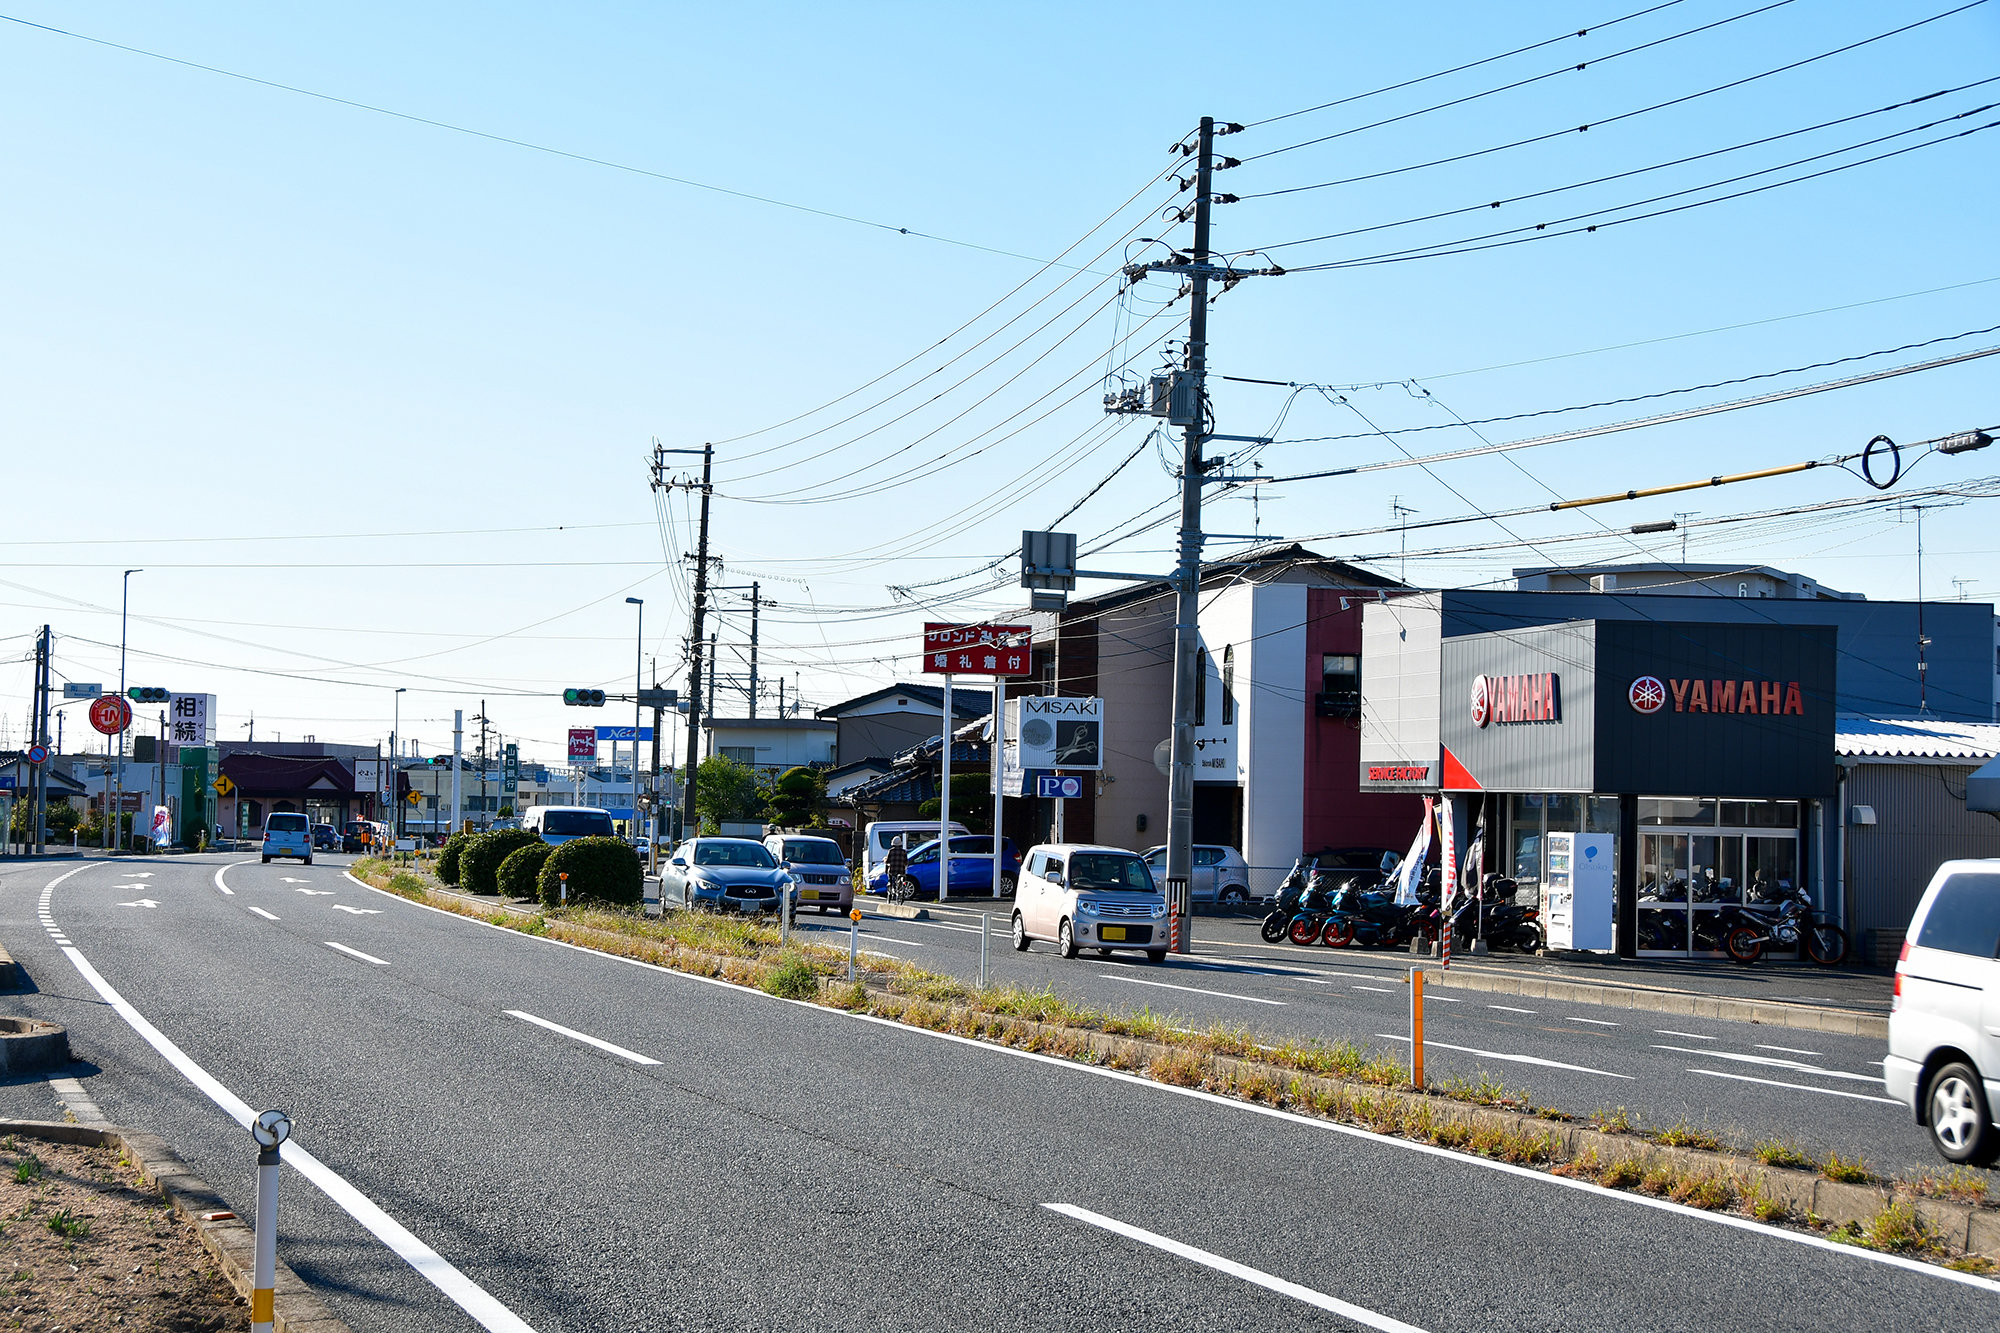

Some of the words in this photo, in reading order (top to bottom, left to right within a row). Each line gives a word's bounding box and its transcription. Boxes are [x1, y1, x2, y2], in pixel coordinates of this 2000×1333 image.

[1739, 582, 1747, 597] 6
[934, 654, 1021, 669] 婚礼着付
[1487, 672, 1554, 723] YAMAHA
[1669, 679, 1803, 715] YAMAHA
[1026, 700, 1098, 715] MISAKI
[174, 696, 197, 742] 相続
[506, 747, 516, 789] 山口銀行
[1368, 767, 1395, 780] SERVICE
[1396, 767, 1428, 780] FACTORY
[1042, 778, 1060, 795] P
